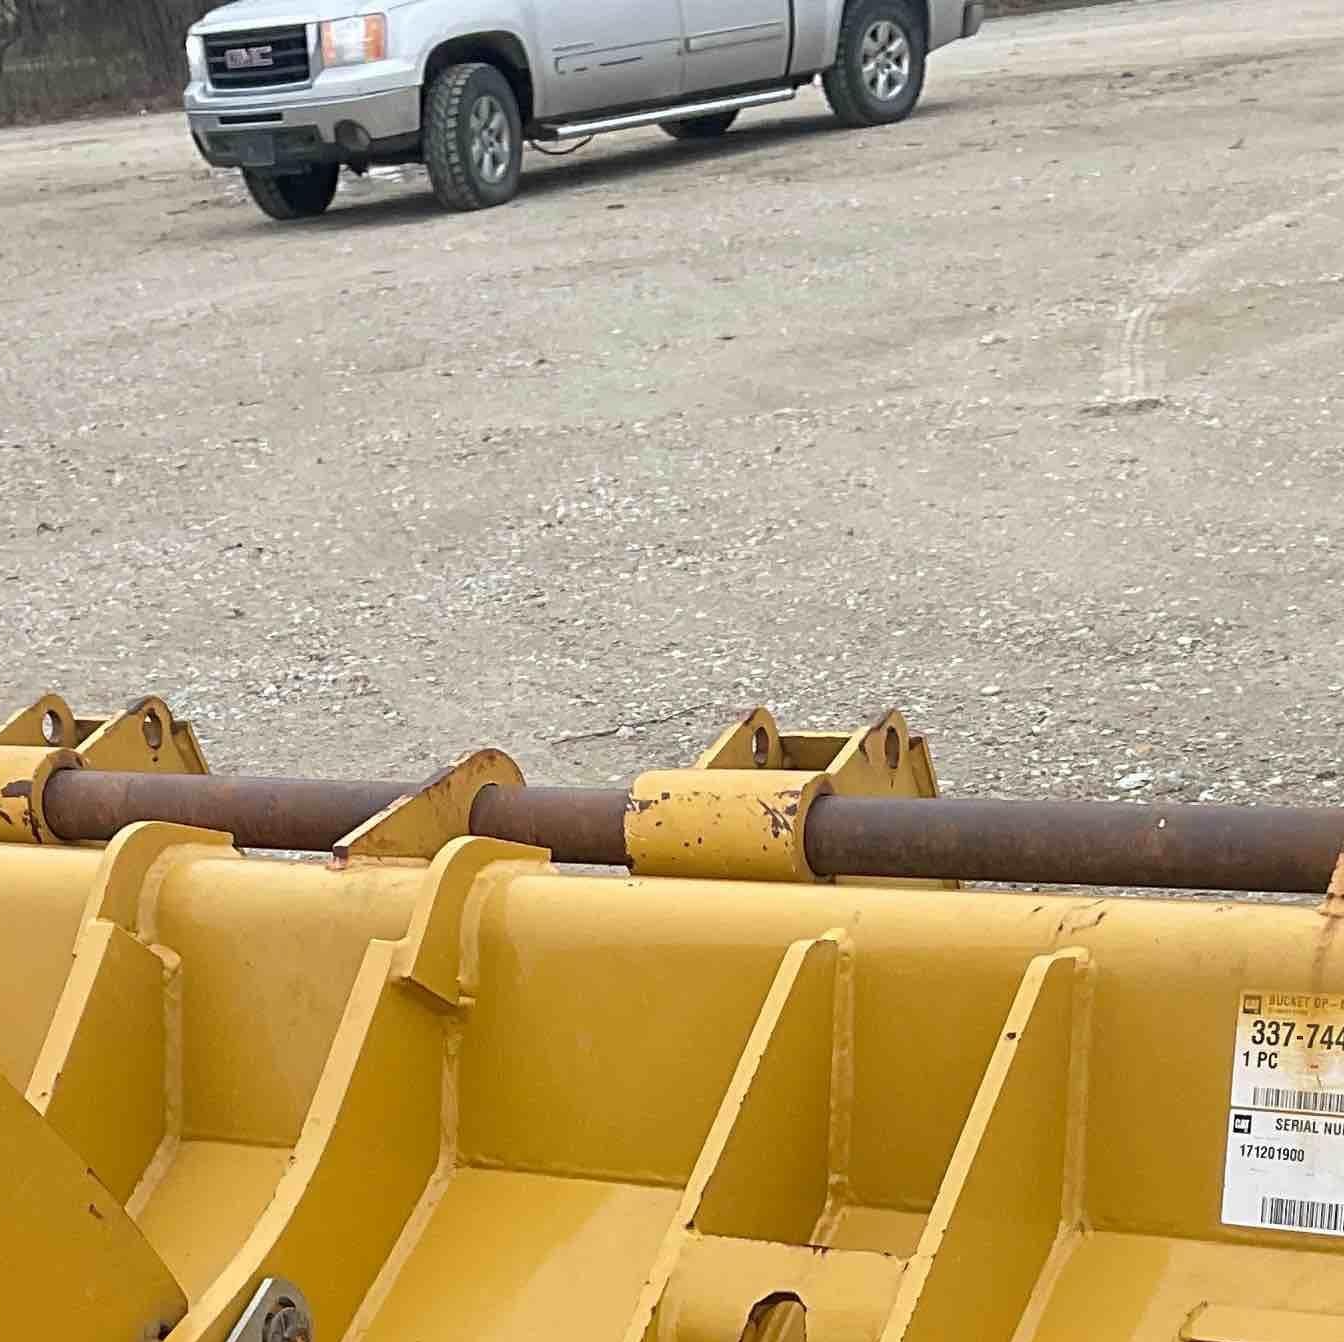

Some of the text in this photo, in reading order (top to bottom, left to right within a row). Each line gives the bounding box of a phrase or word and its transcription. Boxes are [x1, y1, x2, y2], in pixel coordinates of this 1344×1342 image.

[1242, 1051, 1279, 1069] 1 PC
[1274, 1117, 1320, 1134] SERIAL
[1239, 1143, 1305, 1162] 171201900
